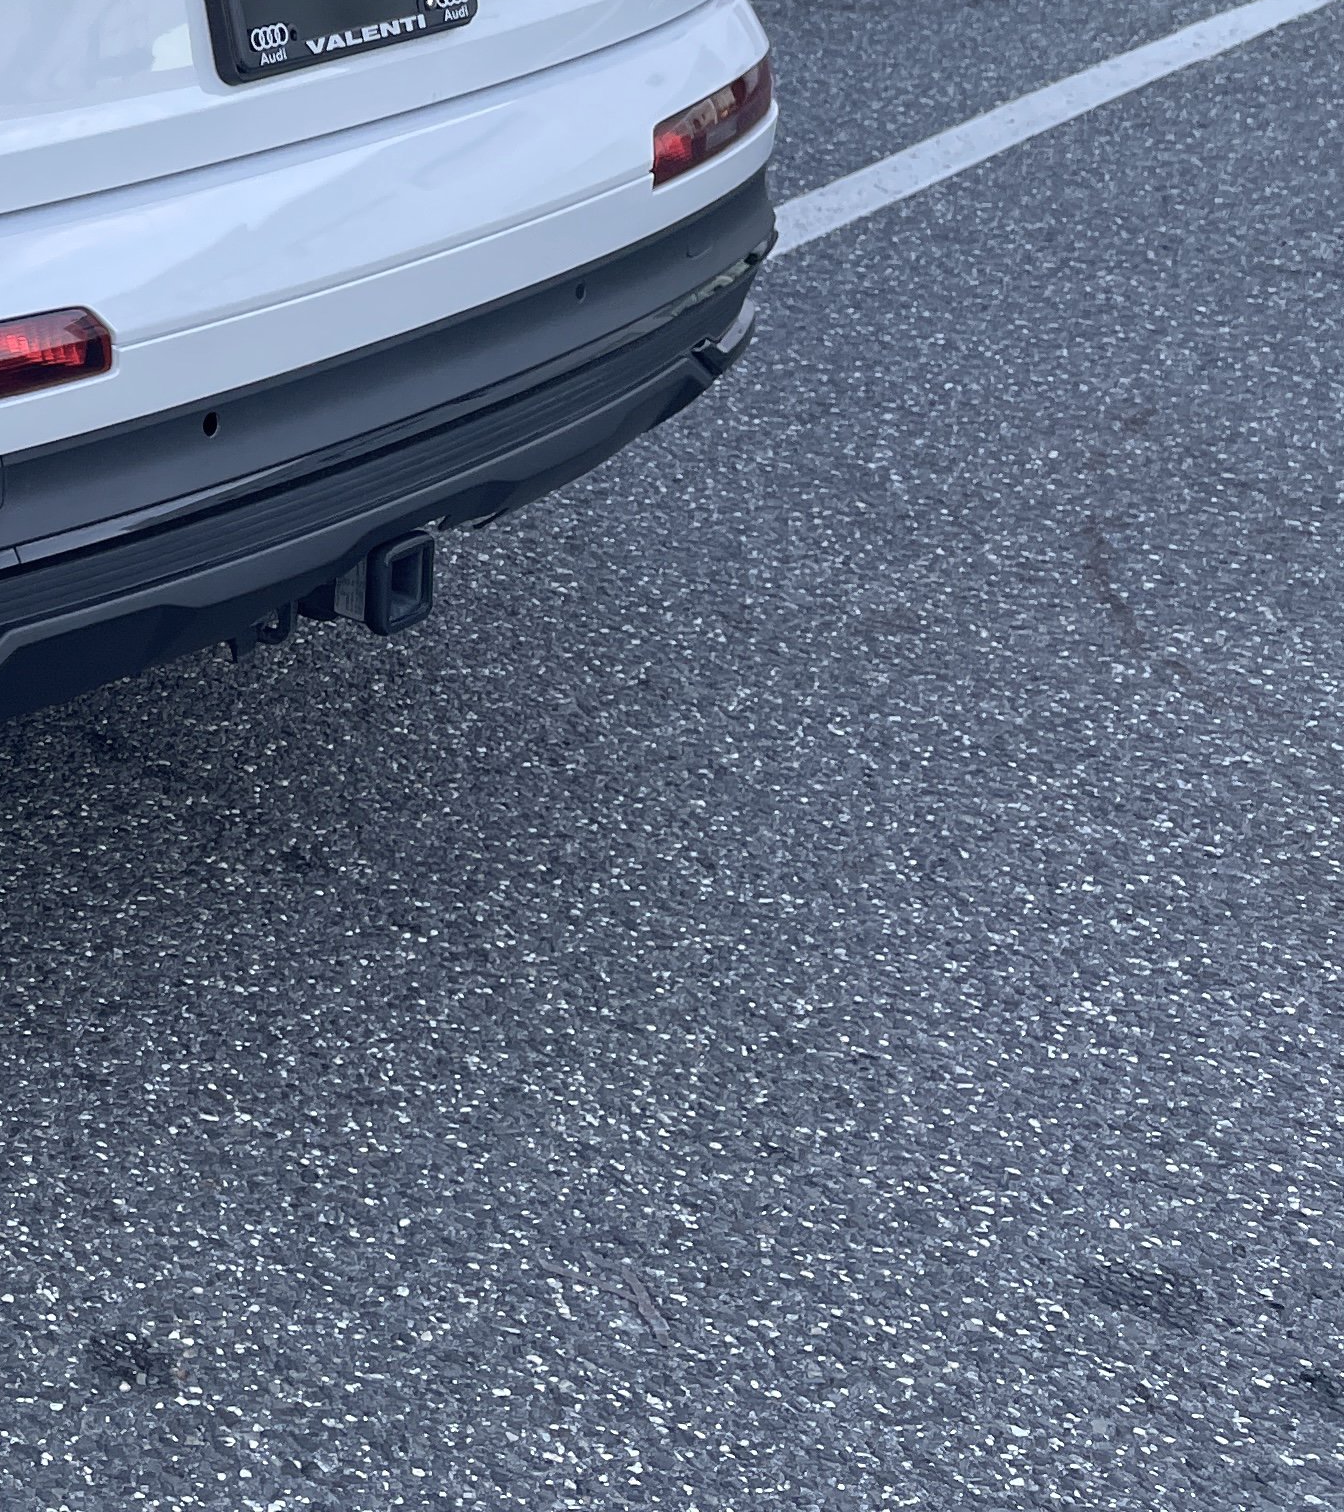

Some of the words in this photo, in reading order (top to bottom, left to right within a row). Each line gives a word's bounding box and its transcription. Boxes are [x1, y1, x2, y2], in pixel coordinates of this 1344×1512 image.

[443, 5, 469, 22] Audi
[305, 13, 428, 55] VALENTI
[259, 47, 288, 66] Audi
